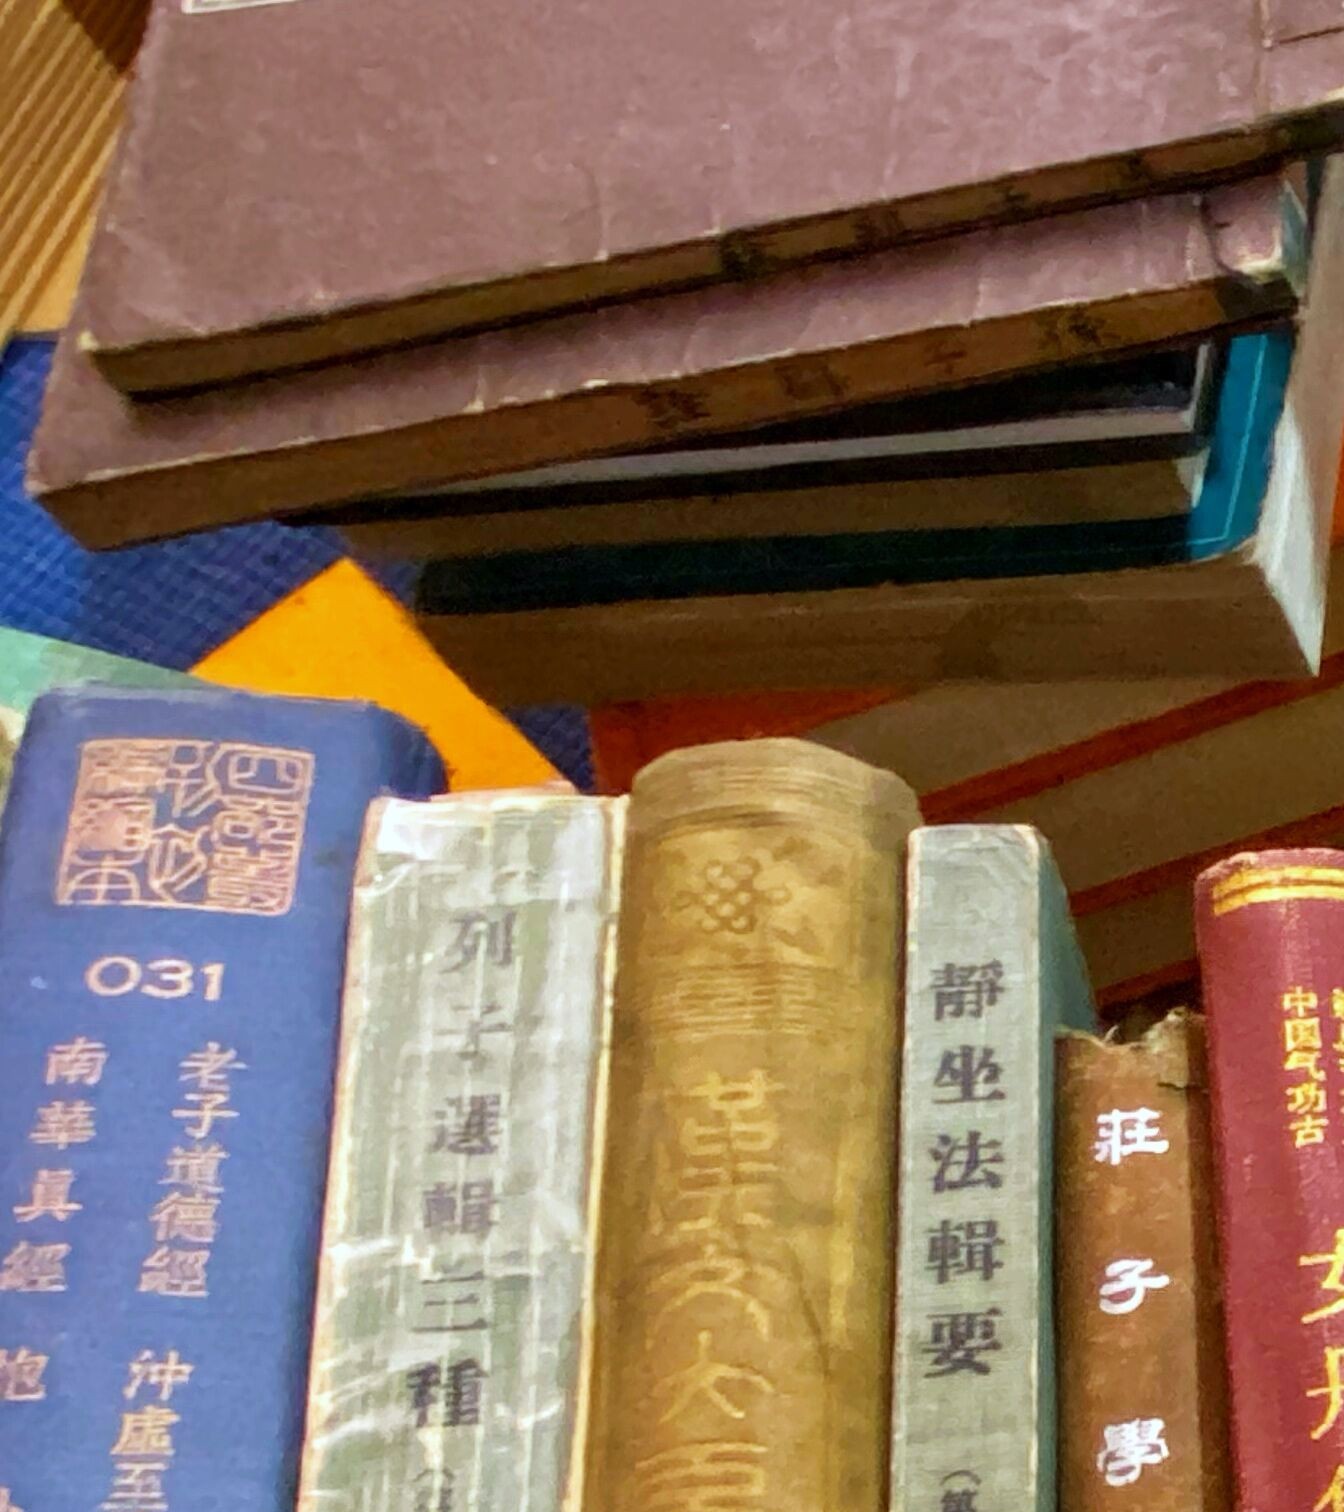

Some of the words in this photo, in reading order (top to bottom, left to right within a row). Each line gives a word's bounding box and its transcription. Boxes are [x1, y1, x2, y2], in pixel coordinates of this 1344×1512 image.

[84, 955, 225, 1001] 031
[1282, 985, 1330, 1149] 中国气功古
[135, 1041, 248, 1297] 老子道德經
[921, 961, 1007, 1379] 靜坐法輯要
